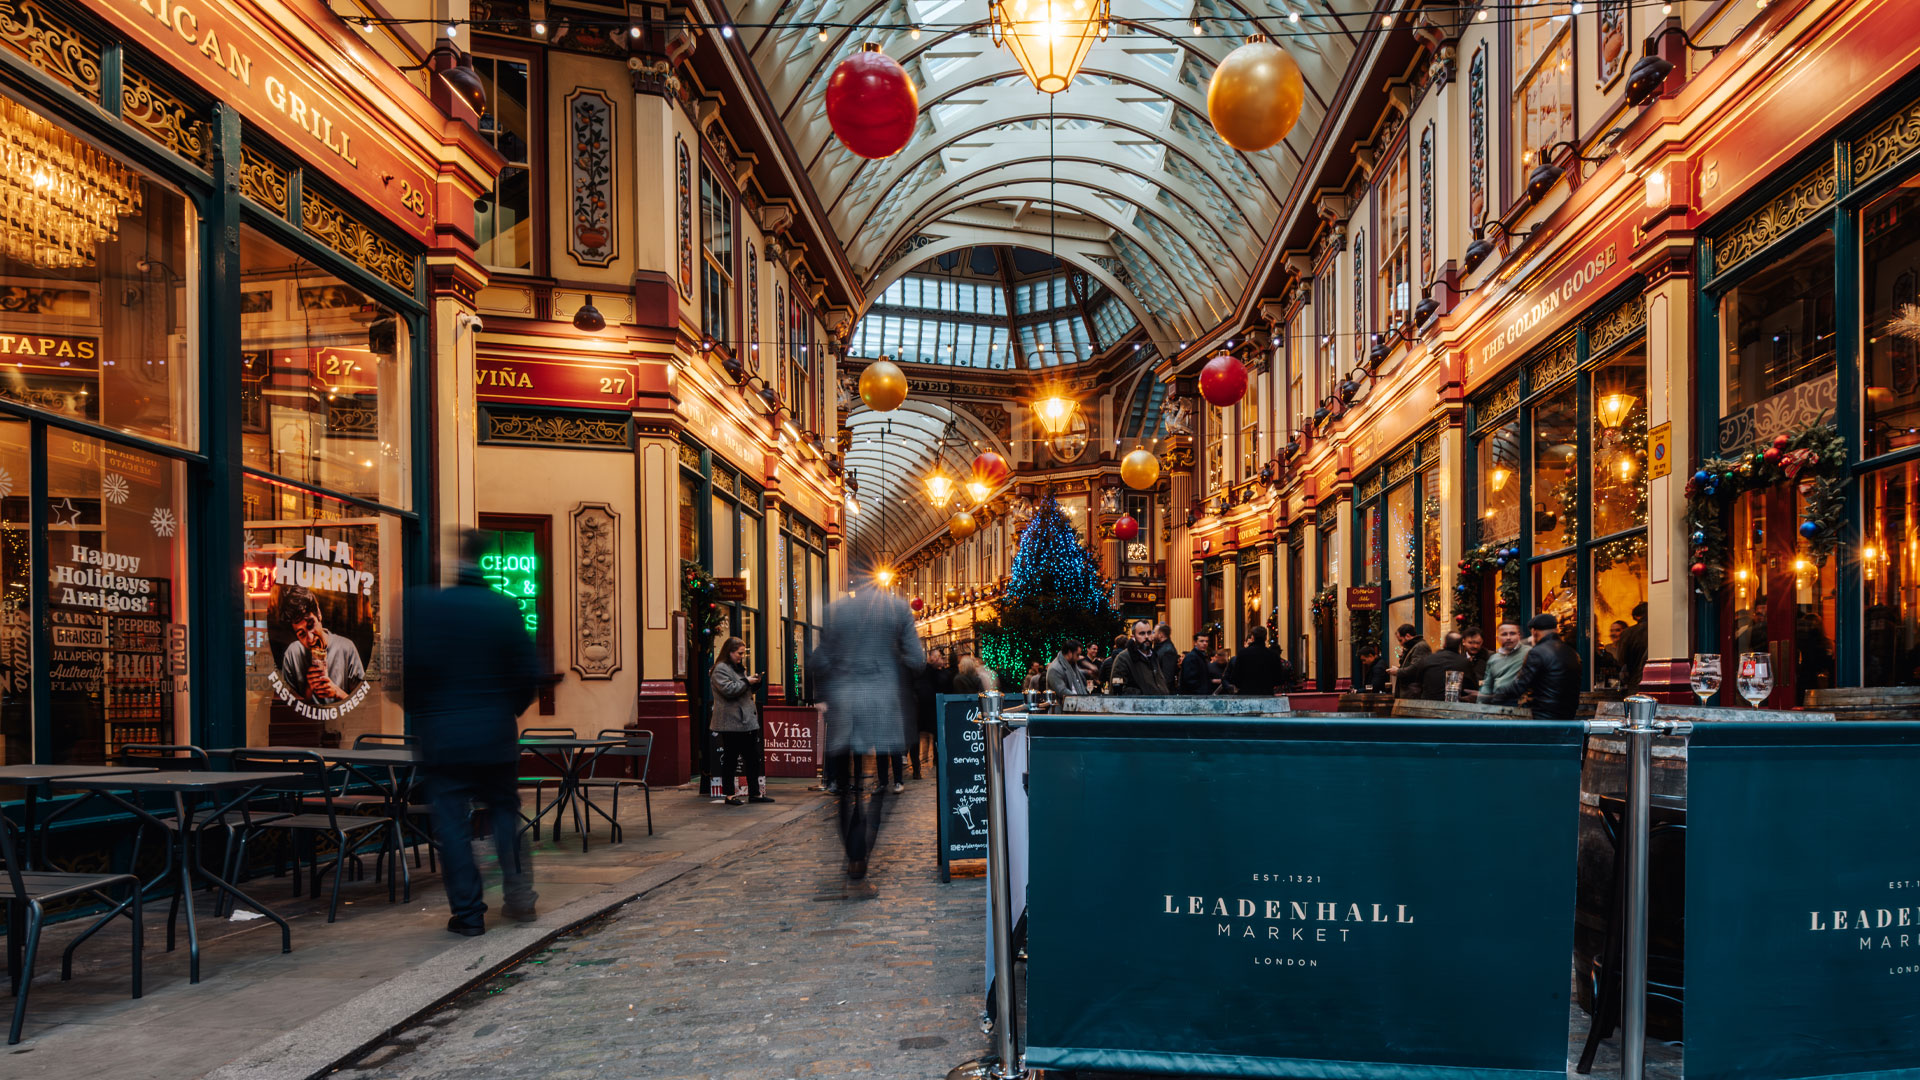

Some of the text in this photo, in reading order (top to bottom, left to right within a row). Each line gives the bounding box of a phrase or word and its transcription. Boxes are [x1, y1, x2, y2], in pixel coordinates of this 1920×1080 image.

[140, 0, 425, 217] ICAN GRILL 28
[1698, 160, 1719, 198] 15
[1482, 331, 1505, 364] THE
[1506, 287, 1561, 345] GOLDEN
[1562, 242, 1617, 301] GOOSE
[0, 336, 95, 359] TAPAS
[326, 356, 355, 376] 27
[476, 367, 626, 394] VIÑA 27
[71, 544, 141, 574] Happy
[305, 534, 350, 565] IN A
[56, 565, 151, 595] Holidays
[275, 557, 375, 596] HURRY?
[523, 580, 536, 595] &
[61, 587, 148, 613] Amigos!
[57, 628, 103, 645] BRAISED
[117, 617, 162, 634] PEPPERS
[116, 653, 164, 680] RICE
[149, 680, 189, 693] TEQULA
[267, 671, 296, 708] FAST
[295, 701, 338, 720] FILLING
[339, 680, 371, 717] FRESH
[768, 721, 812, 738] Viña
[791, 739, 812, 749] 2021
[770, 752, 780, 762] &
[783, 752, 812, 764] Tapas
[1253, 873, 1322, 884] EST.1321
[1163, 894, 1415, 924] LEADENHALL
[1218, 923, 1350, 943] MARKET
[1254, 957, 1318, 968] LONDON
[1889, 964, 1920, 975] LOND
